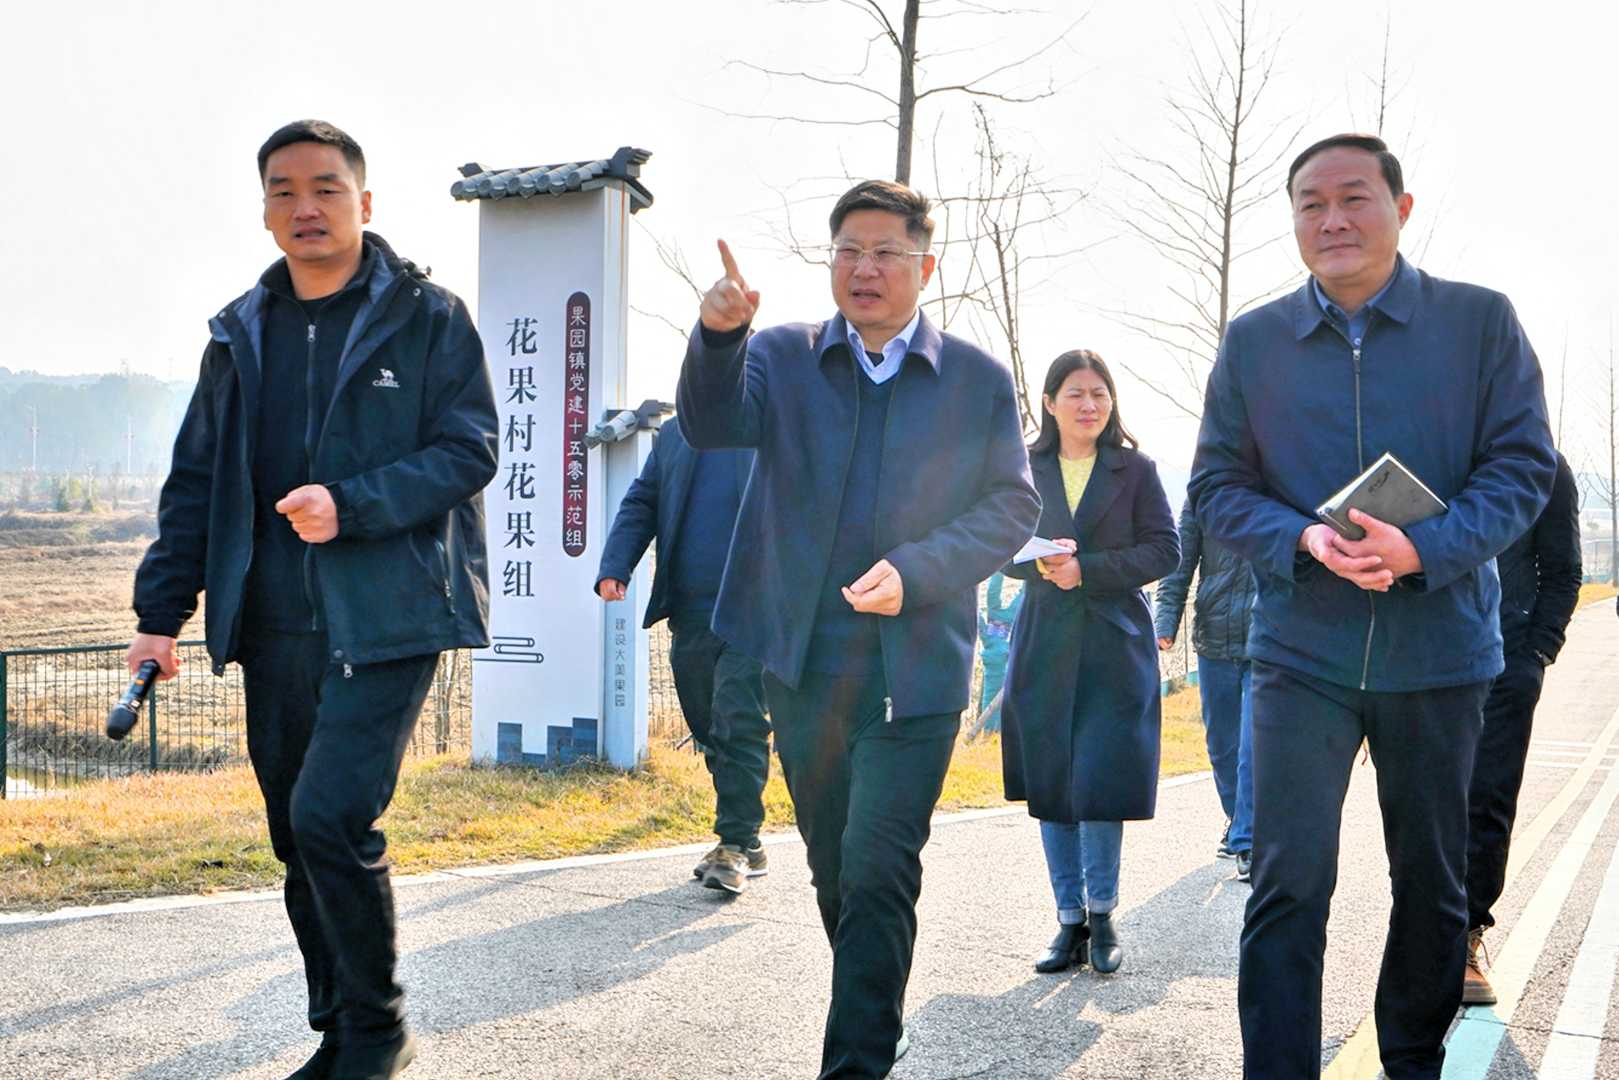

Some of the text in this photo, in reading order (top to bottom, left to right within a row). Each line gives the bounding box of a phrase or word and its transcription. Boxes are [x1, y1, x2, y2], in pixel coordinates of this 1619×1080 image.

[503, 317, 538, 597] 花果村花果组
[566, 305, 587, 548] 果园镇党建十五零示范组
